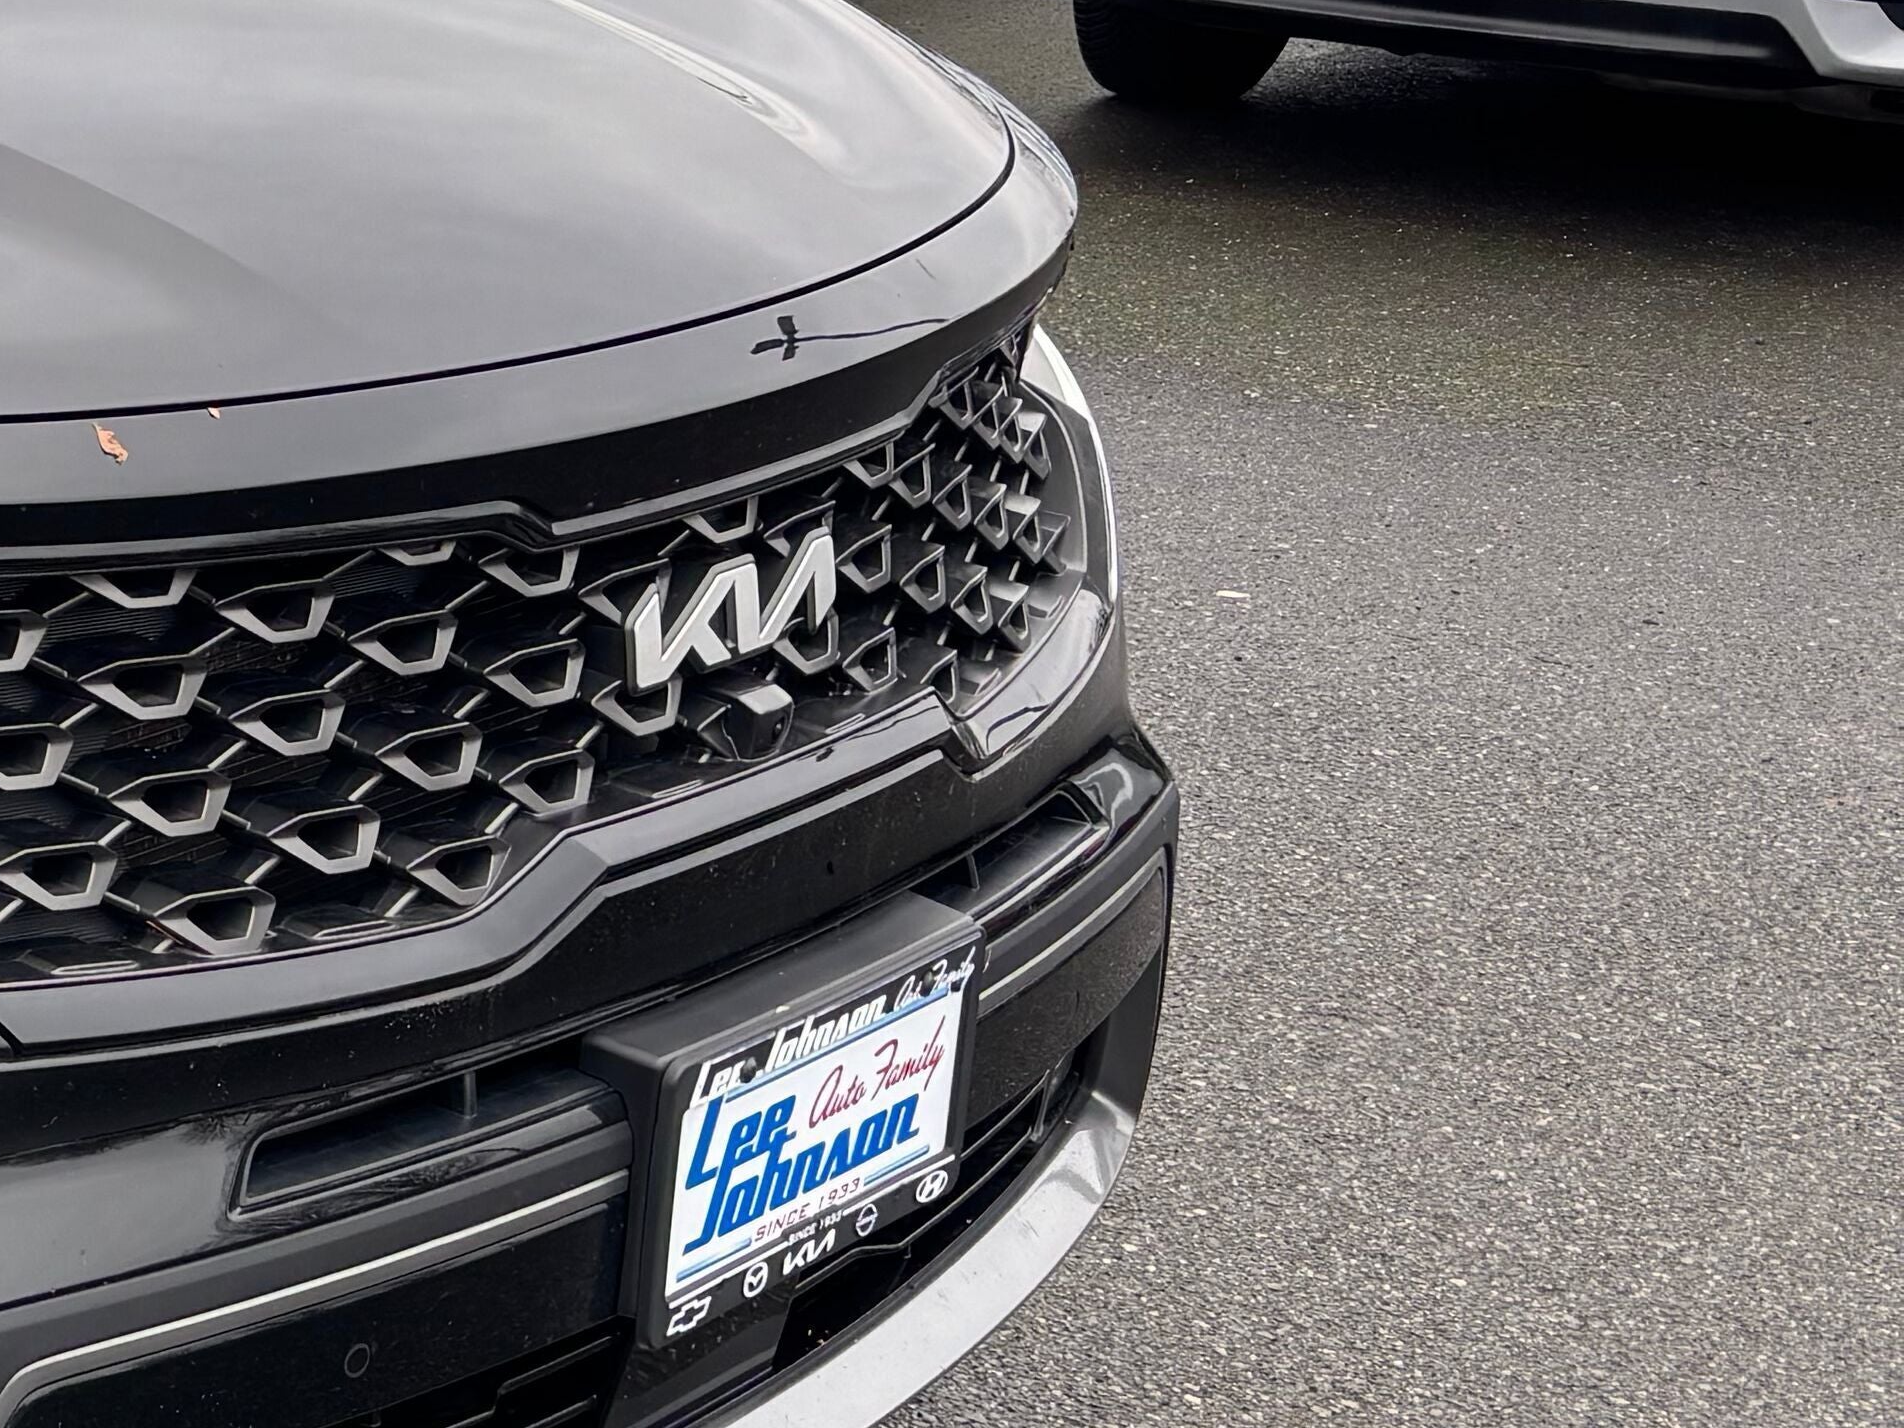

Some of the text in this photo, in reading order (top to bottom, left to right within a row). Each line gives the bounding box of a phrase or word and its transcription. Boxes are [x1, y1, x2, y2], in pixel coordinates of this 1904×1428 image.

[756, 994, 893, 1078] Johnson
[809, 1016, 945, 1129] Auto Family
[683, 1092, 920, 1256] Johnson
[685, 1093, 797, 1190] Lee
[754, 1177, 861, 1243] SINCE 1933
